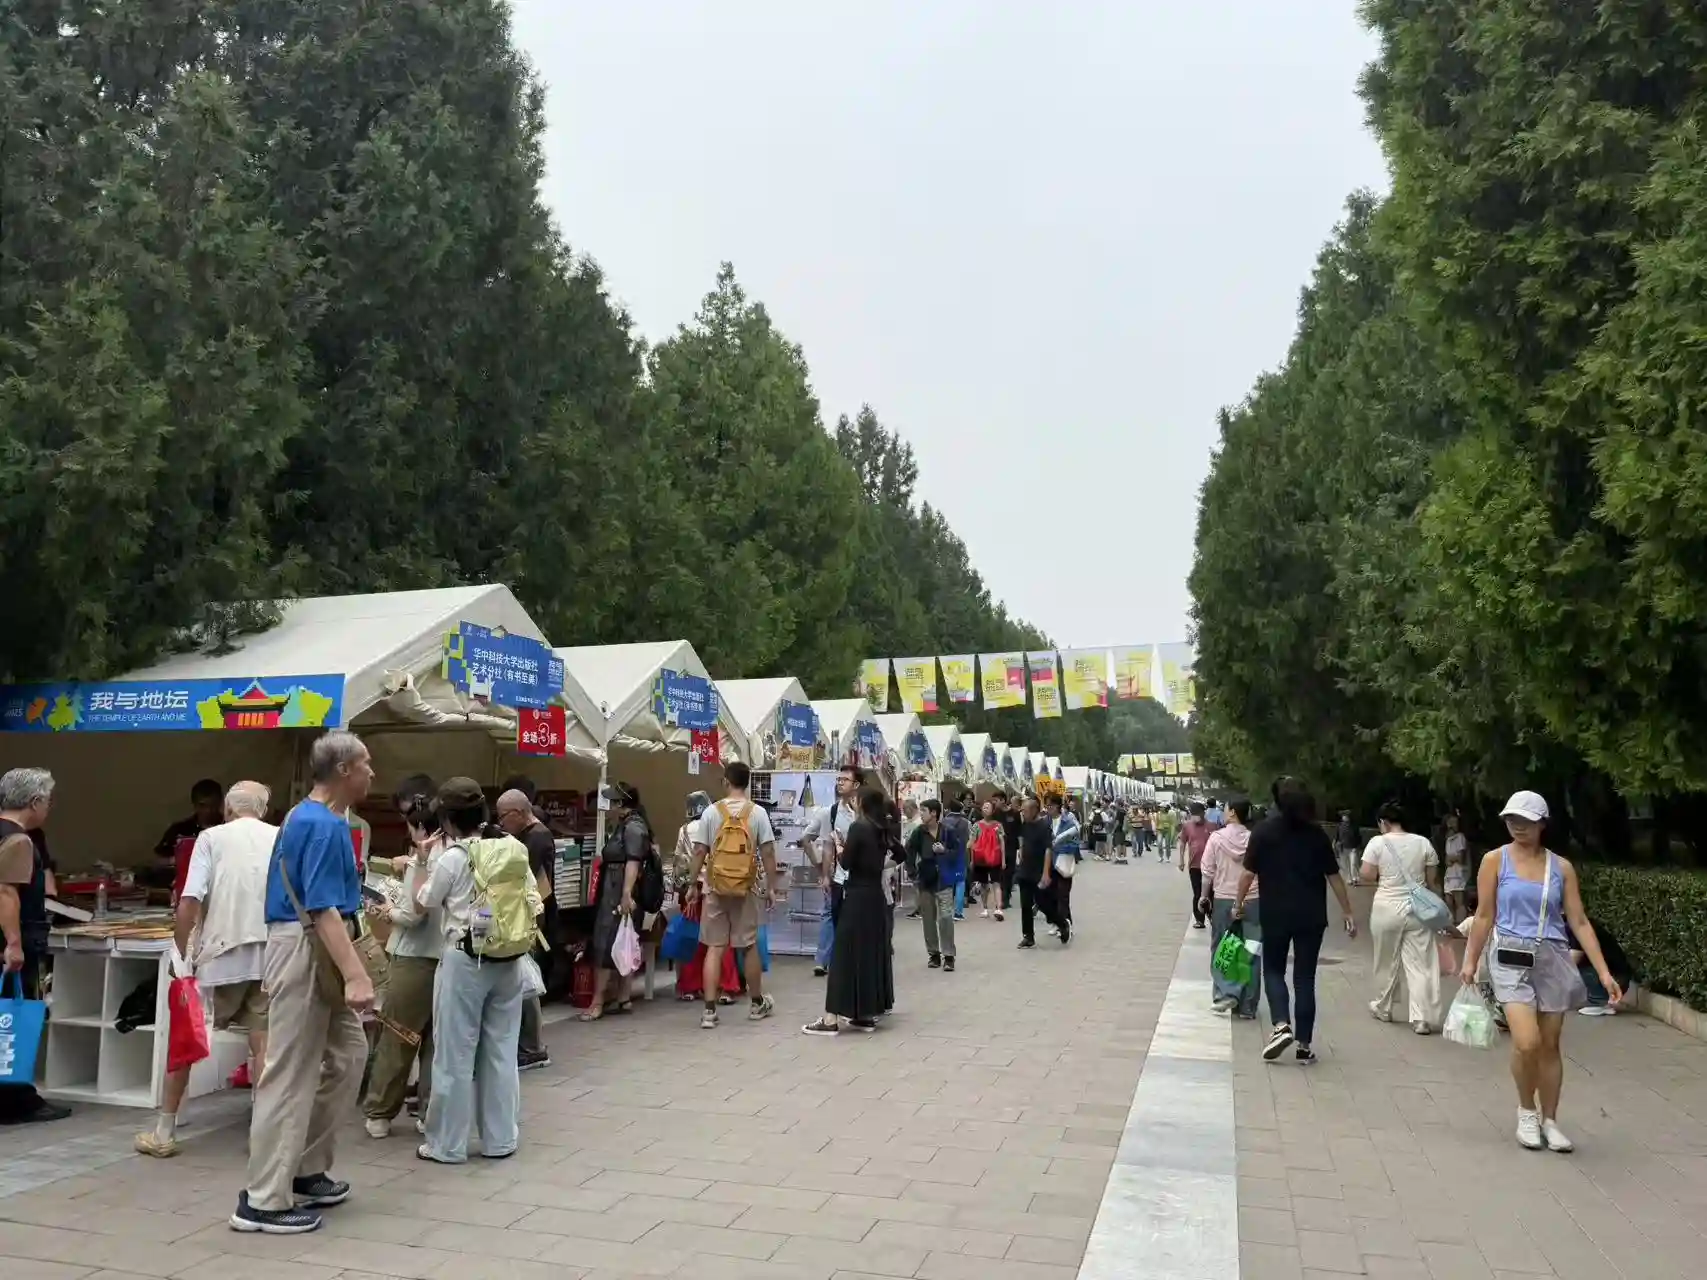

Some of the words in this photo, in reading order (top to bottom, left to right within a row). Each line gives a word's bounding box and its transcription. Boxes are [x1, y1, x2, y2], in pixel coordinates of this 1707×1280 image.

[472, 647, 539, 672] 华中科技大学出版社
[91, 691, 188, 710] 我与地坛
[88, 714, 100, 722] THE
[102, 714, 127, 722] TEMPLE
[137, 713, 160, 721] EARTH
[161, 712, 175, 721] AND
[177, 712, 187, 720] ME
